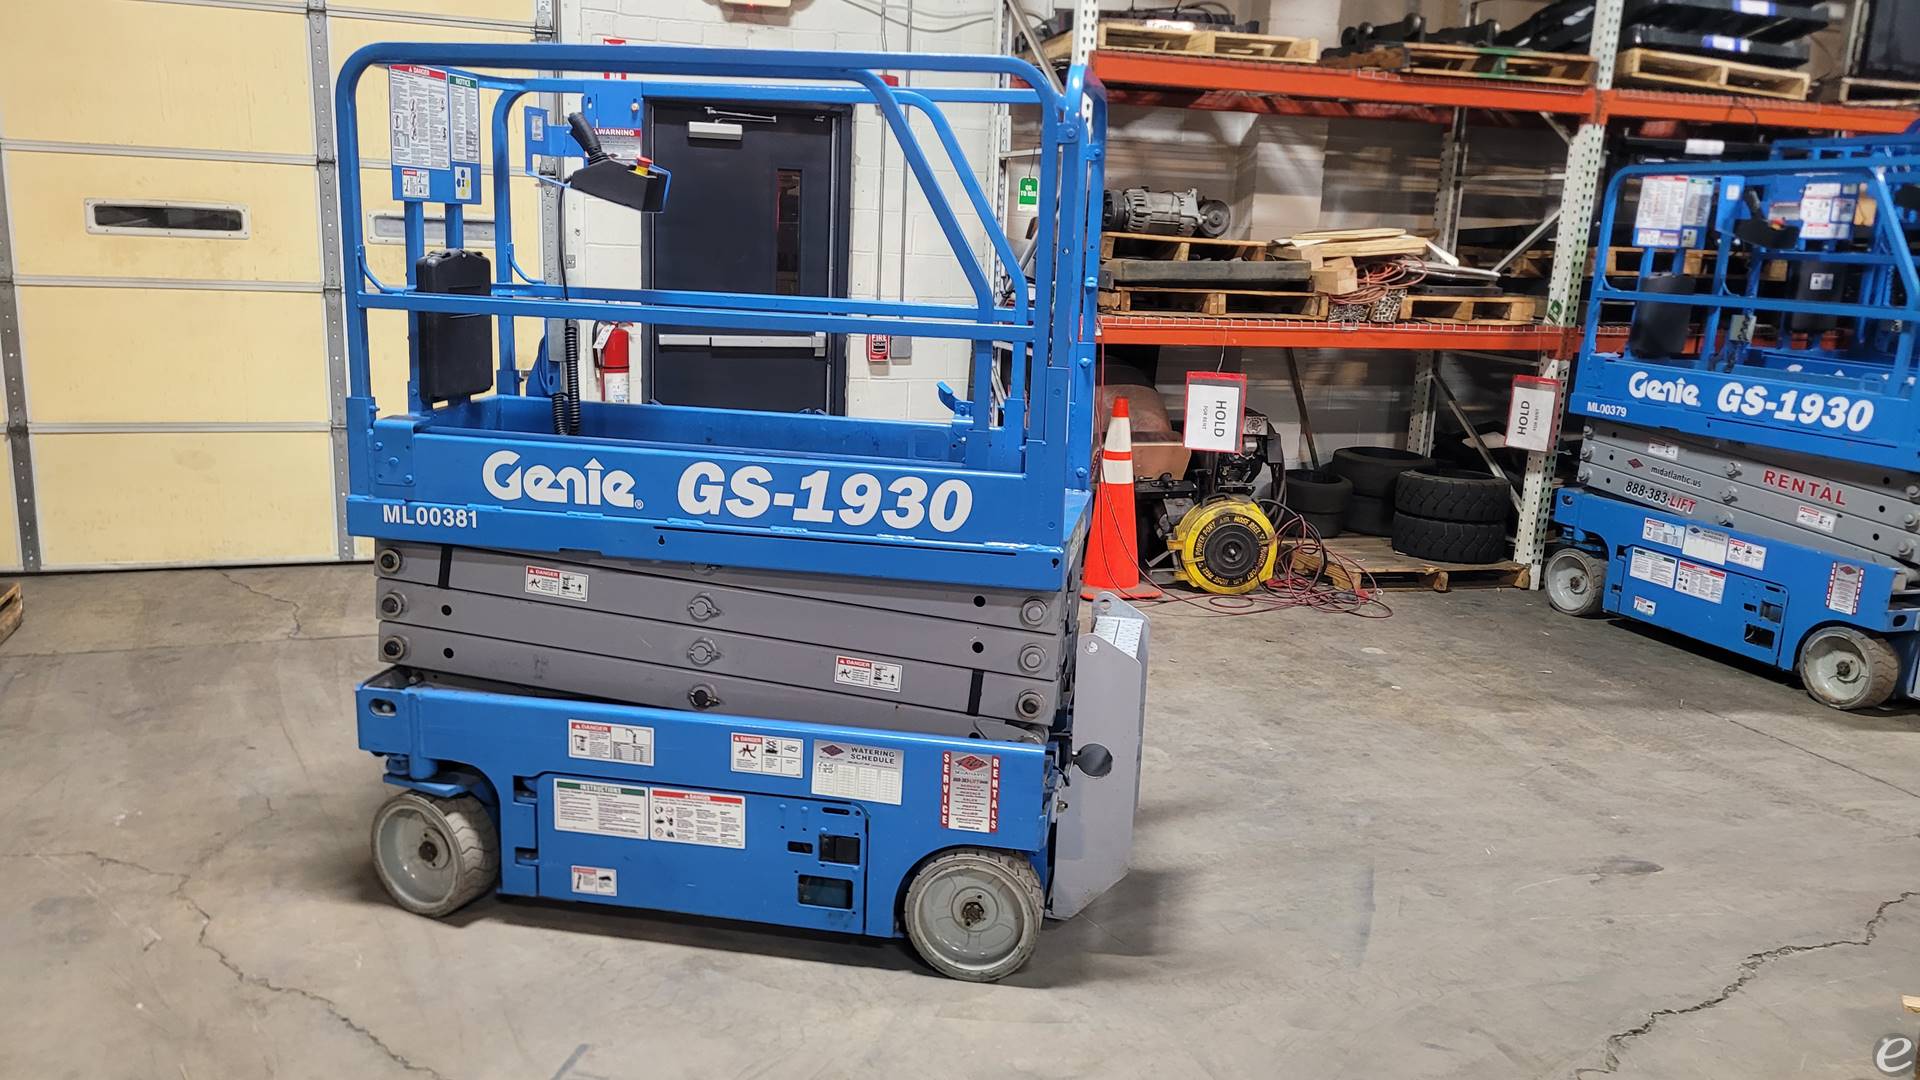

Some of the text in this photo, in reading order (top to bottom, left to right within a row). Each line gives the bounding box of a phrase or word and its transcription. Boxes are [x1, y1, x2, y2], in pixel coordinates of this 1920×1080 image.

[598, 128, 635, 136] WARNING
[1628, 371, 1700, 406] Genie
[1213, 400, 1227, 437] HOLD
[1517, 400, 1530, 435] HOLD
[1587, 401, 1627, 417] ML00379
[1717, 381, 1874, 432] GS-1930
[482, 450, 636, 508] Genie
[1650, 465, 1702, 488] midatlantic.us
[1763, 469, 1847, 506] RENTAL
[677, 461, 973, 533] GS-1930
[382, 504, 477, 528] ML00381
[535, 569, 559, 577] DANGER
[846, 659, 870, 668] DANGER
[581, 724, 608, 732] DANGER
[740, 736, 762, 744] DANGER
[850, 753, 895, 764] SCHEDULE
[851, 746, 895, 757] WATERING
[941, 753, 950, 824] SERVICE
[990, 758, 1000, 829] RENTALS
